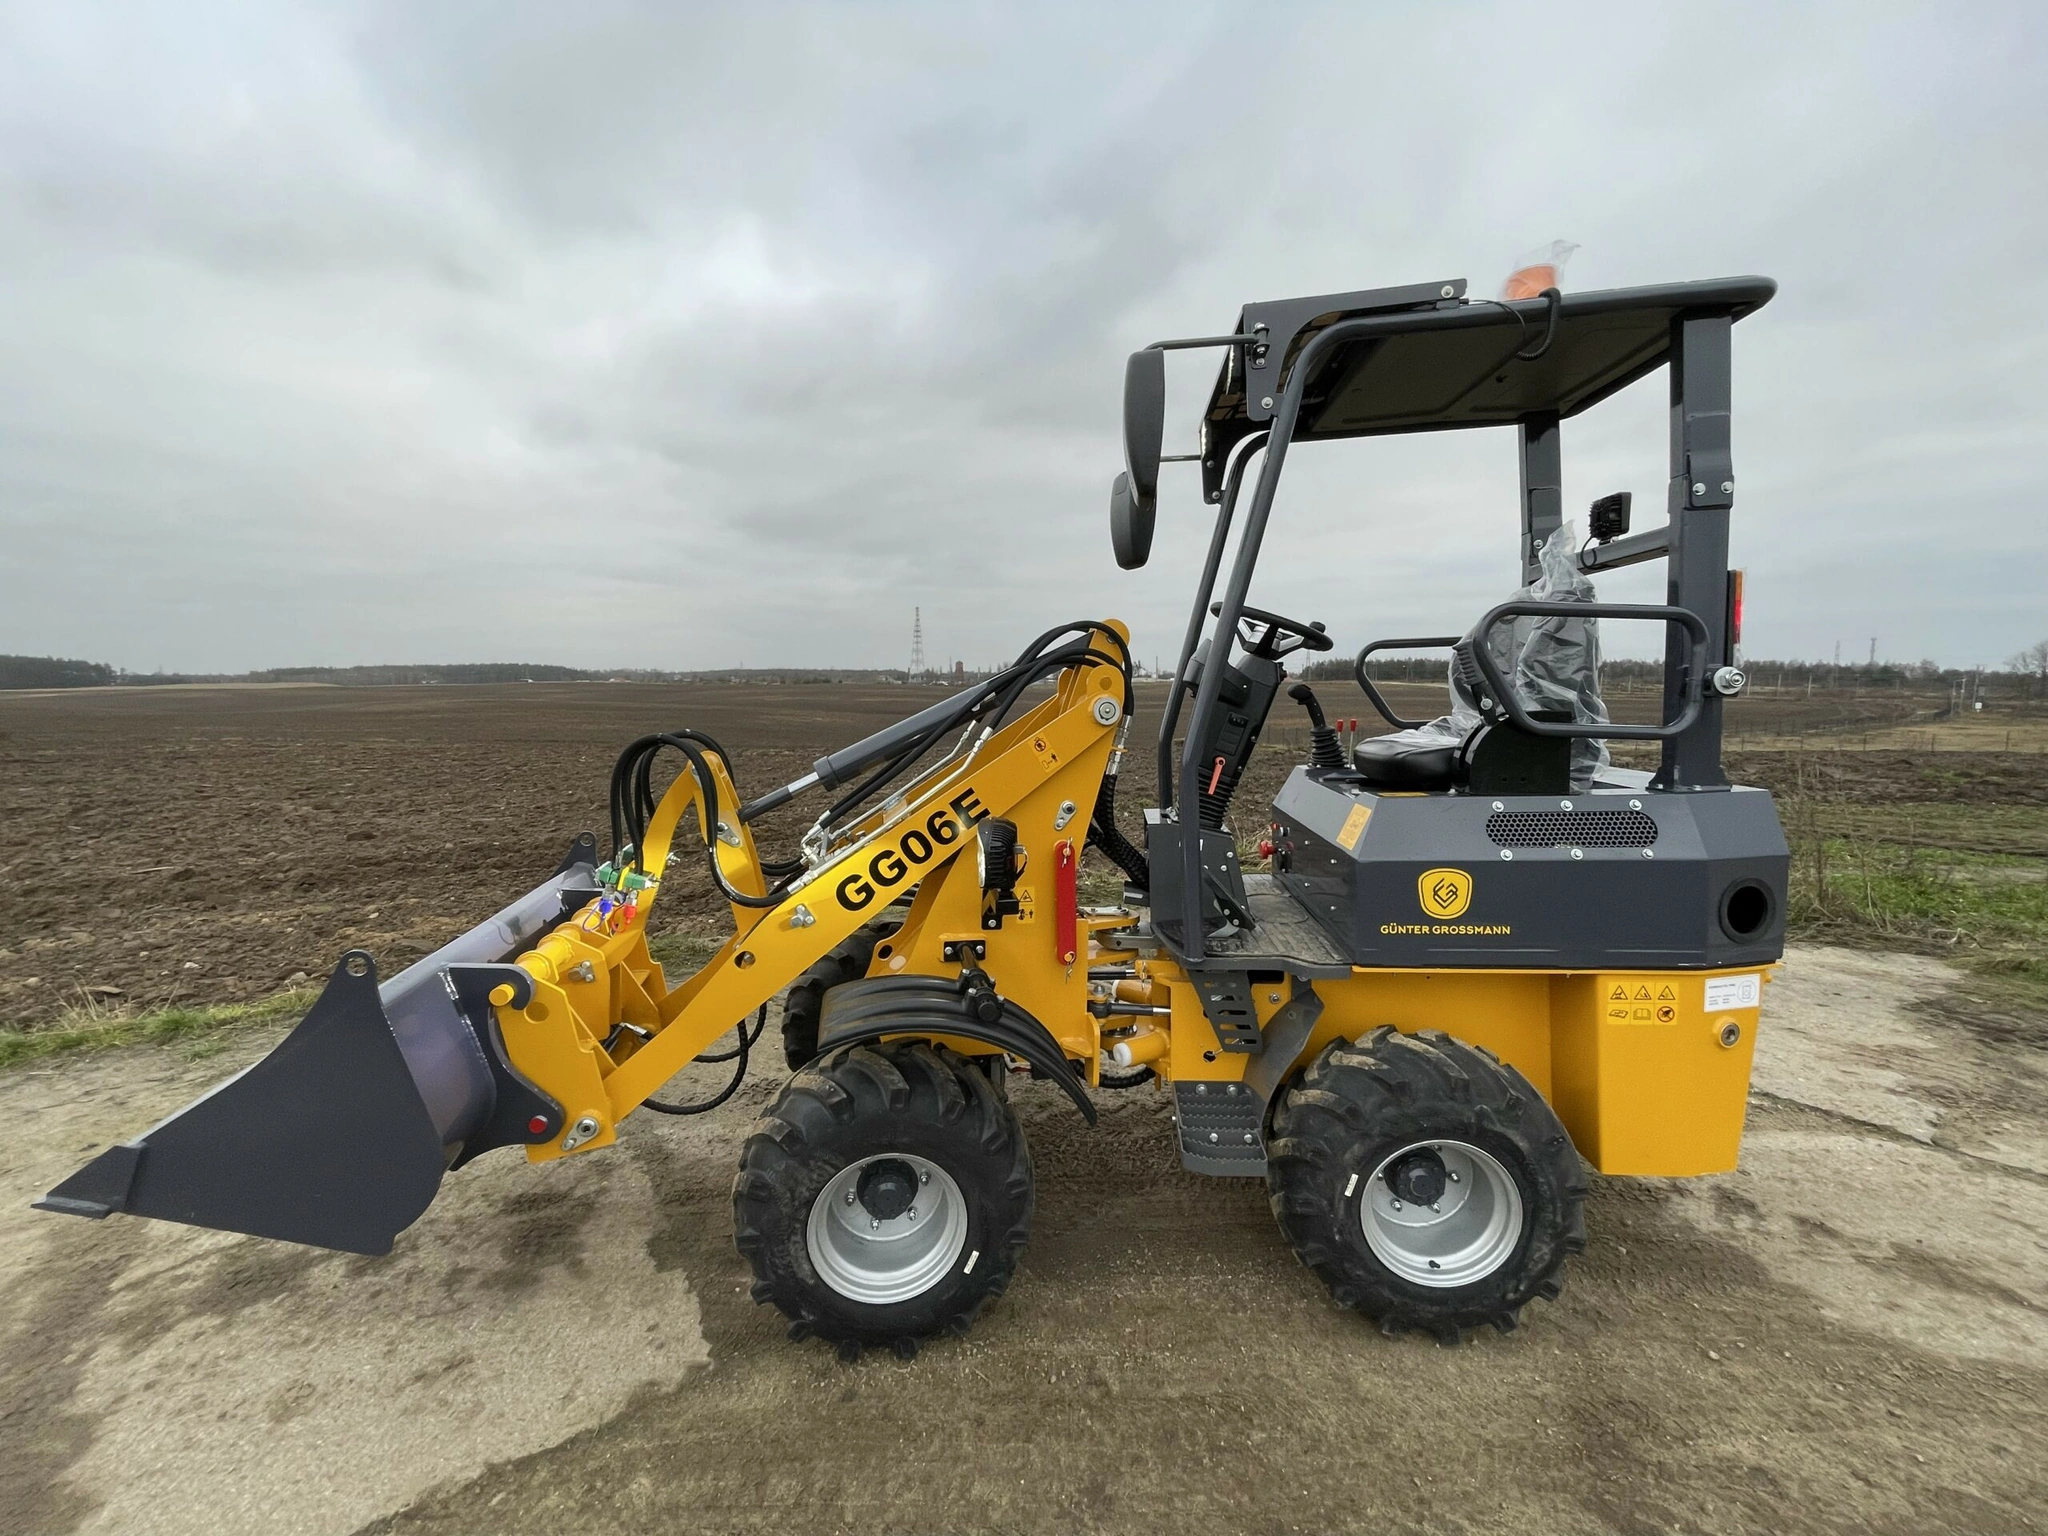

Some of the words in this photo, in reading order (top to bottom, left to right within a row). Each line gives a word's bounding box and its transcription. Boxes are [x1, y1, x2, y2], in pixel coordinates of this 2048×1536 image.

[836, 787, 991, 911] GG06E
[1380, 922, 1430, 934] GÜNTER
[1432, 925, 1511, 935] GROSSMANN
